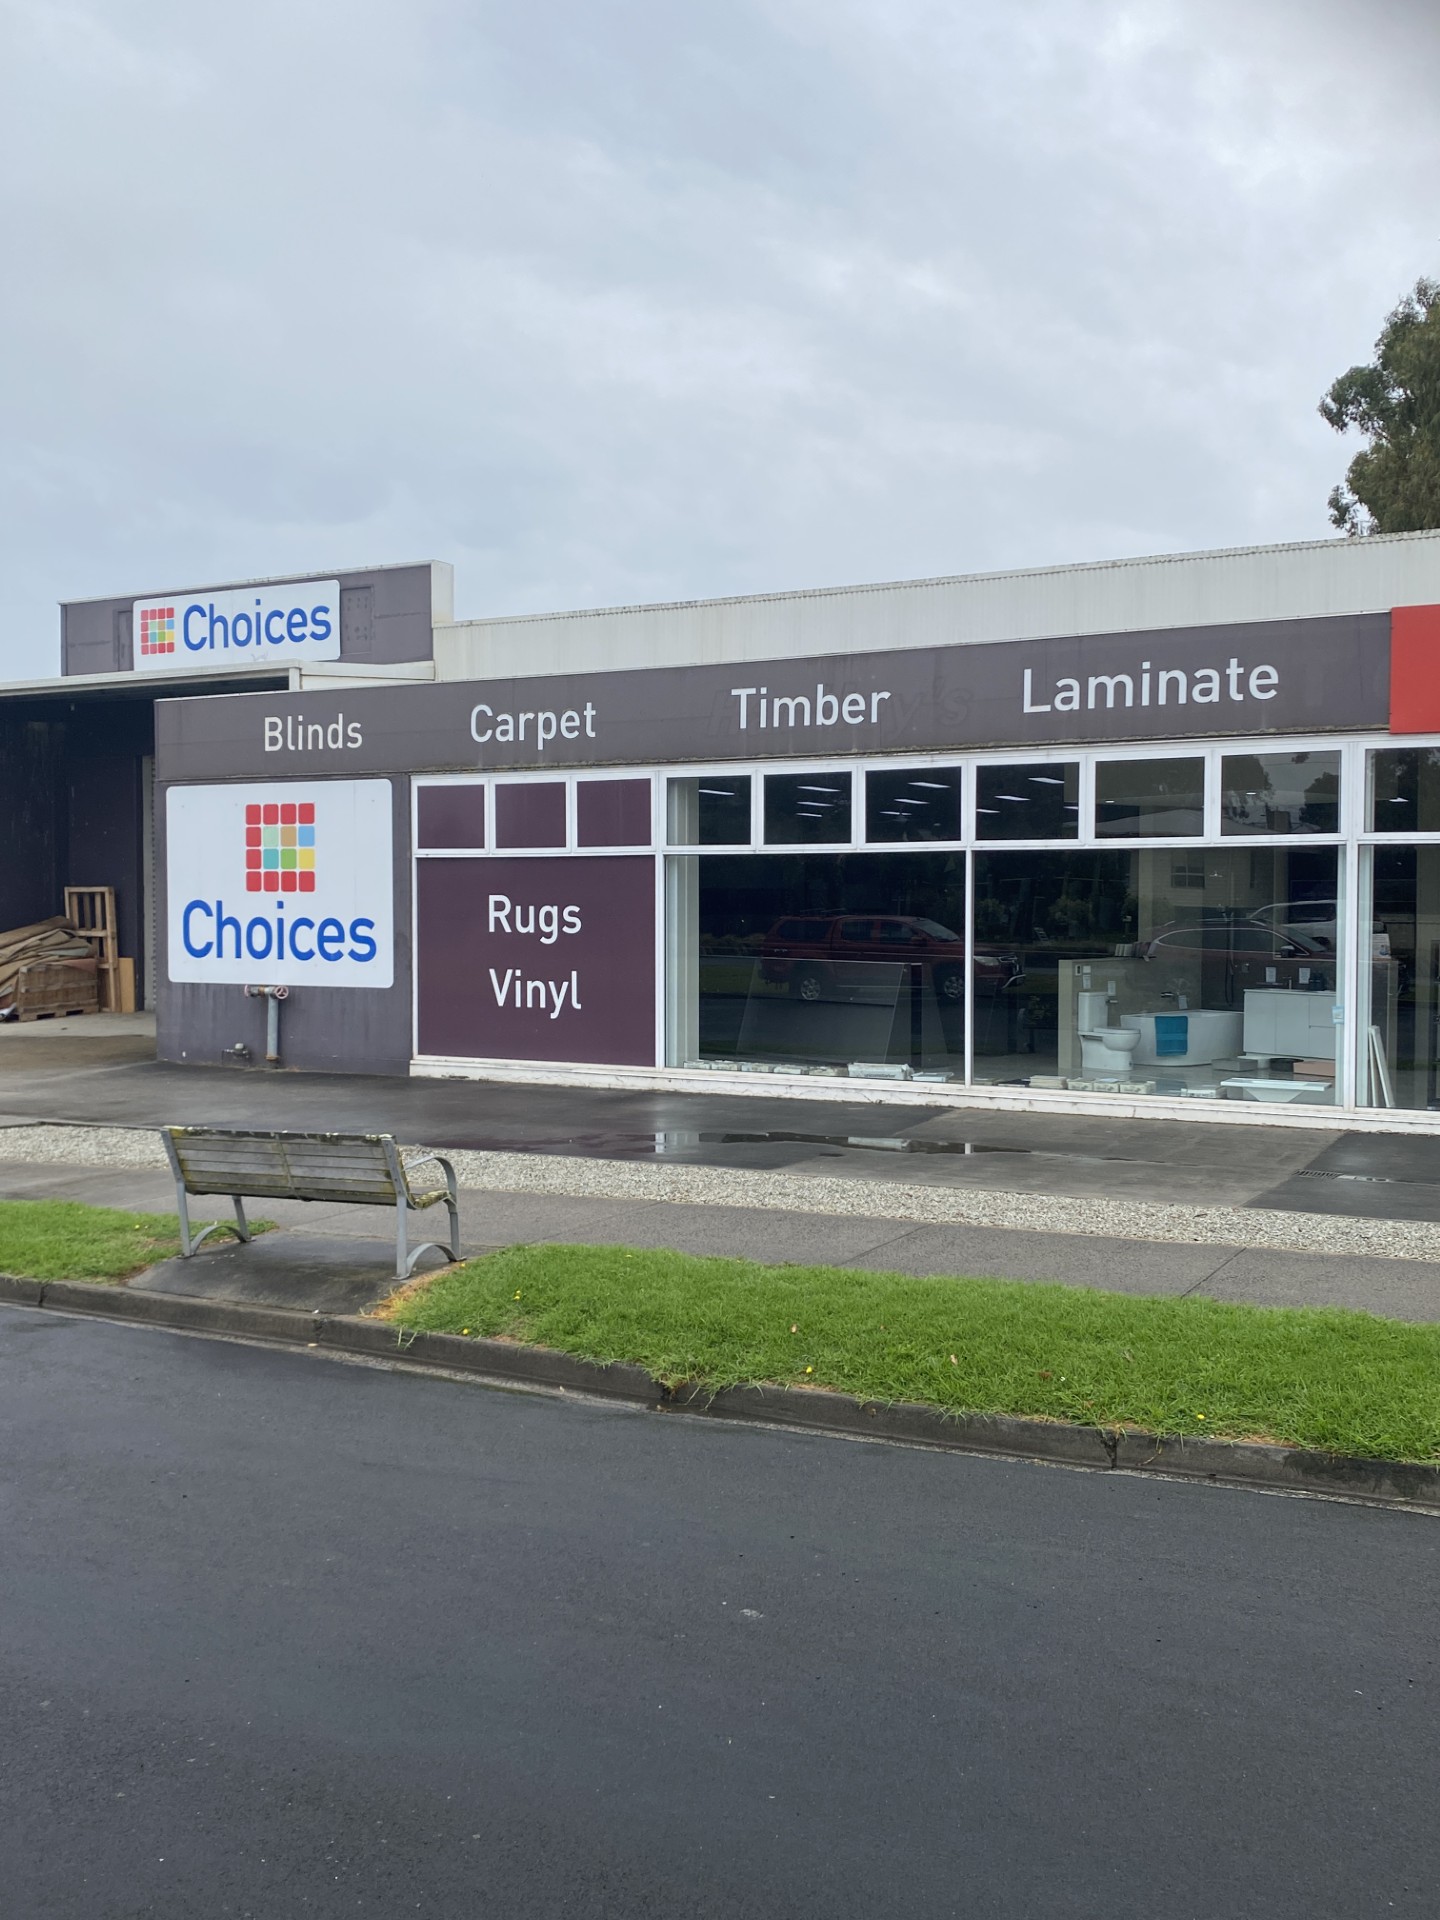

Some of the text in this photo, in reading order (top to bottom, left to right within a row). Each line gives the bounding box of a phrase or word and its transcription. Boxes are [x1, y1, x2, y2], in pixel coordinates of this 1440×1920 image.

[182, 599, 333, 651] Choices
[730, 684, 892, 730] Timber
[1022, 658, 1279, 714] Laminate
[264, 713, 363, 752] Blinds
[470, 702, 597, 750] Carpet
[182, 899, 378, 963] Choices
[488, 895, 582, 944] Rugs
[488, 969, 582, 1019] Vinyl
